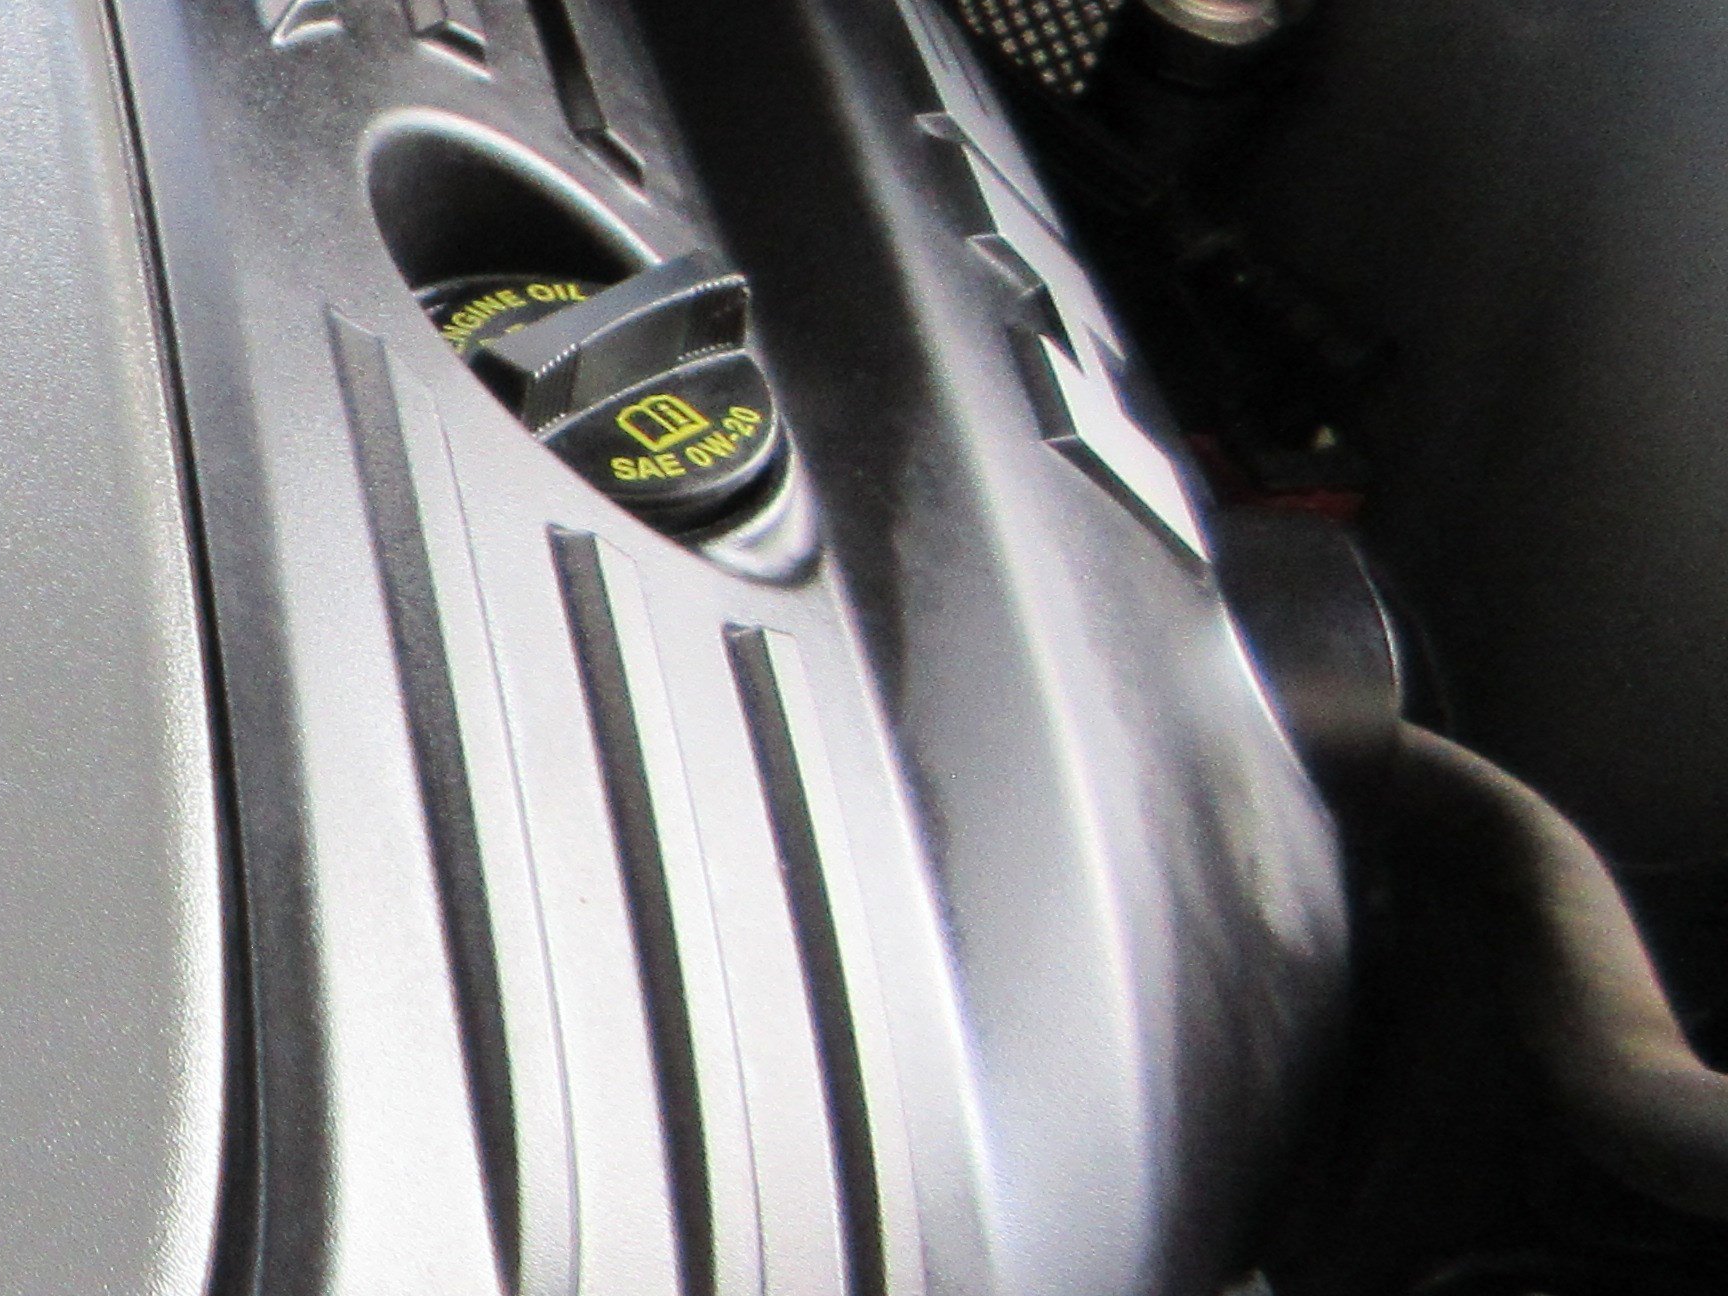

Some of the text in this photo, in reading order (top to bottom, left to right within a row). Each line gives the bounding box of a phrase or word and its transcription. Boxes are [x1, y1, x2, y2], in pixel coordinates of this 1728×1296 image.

[443, 282, 590, 354] NGINE OIL
[609, 452, 688, 482] SAE
